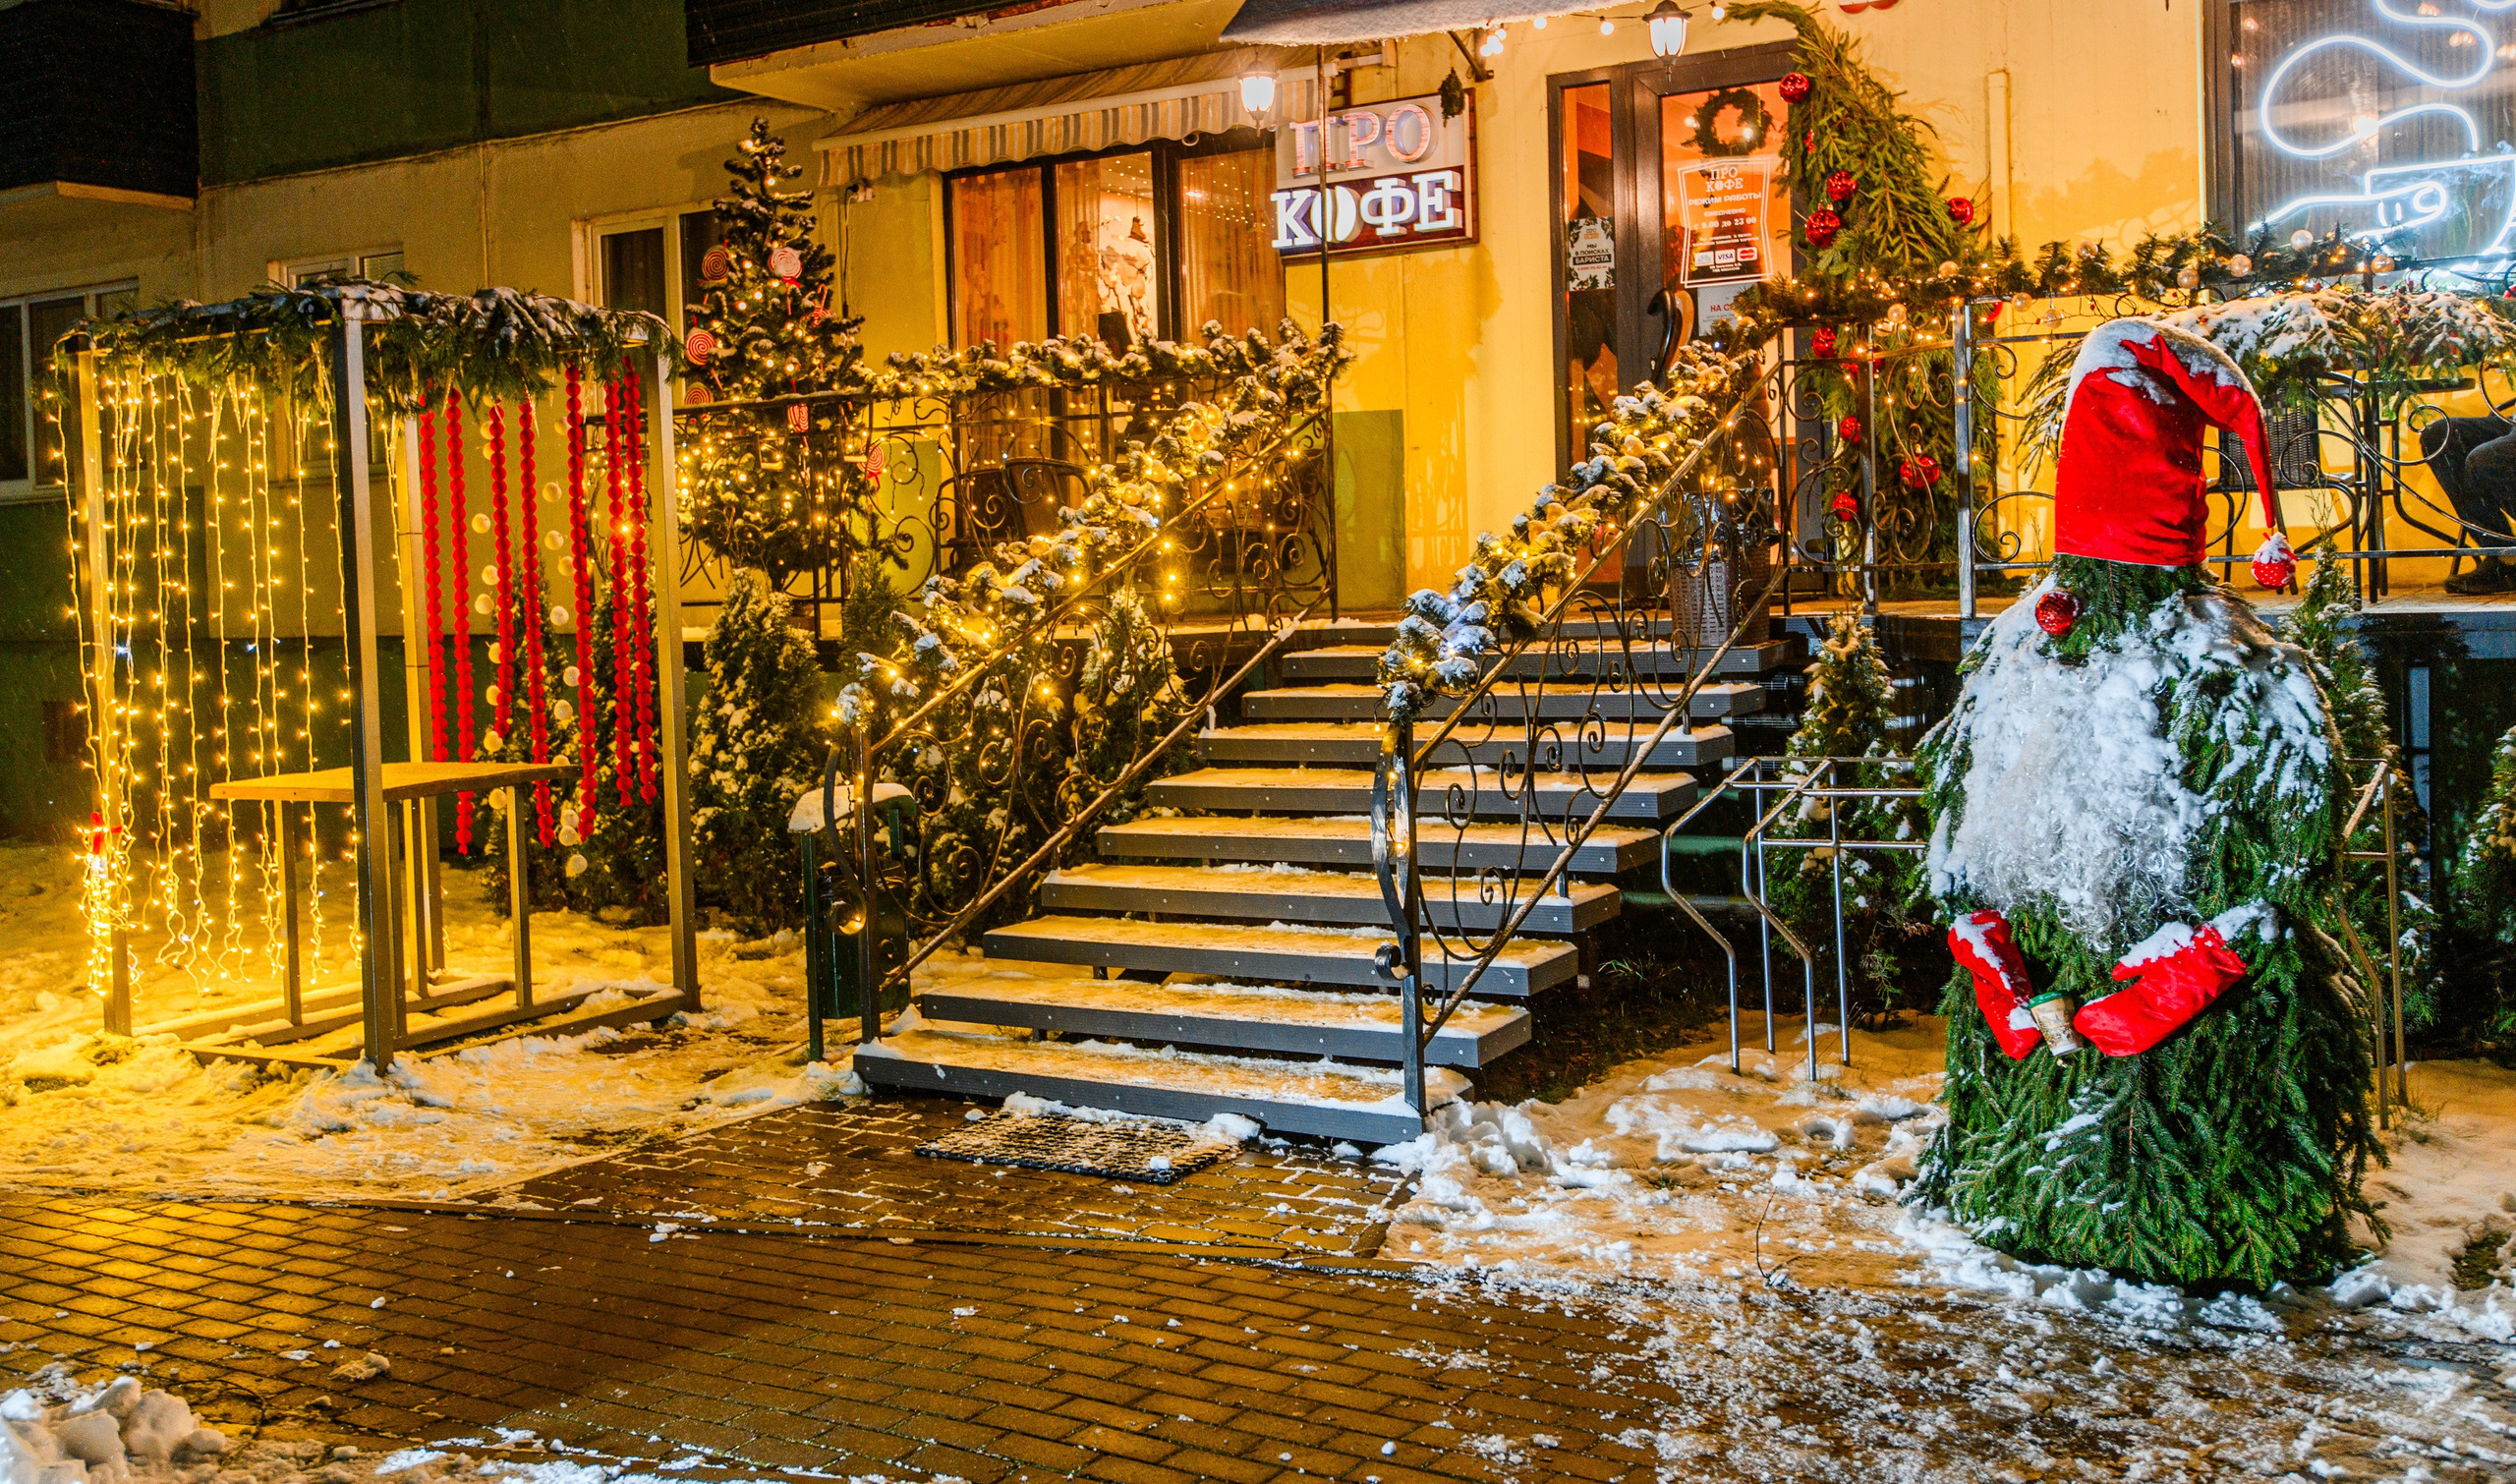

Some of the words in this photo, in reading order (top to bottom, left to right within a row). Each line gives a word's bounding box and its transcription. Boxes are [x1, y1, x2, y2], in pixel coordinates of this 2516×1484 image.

[1289, 103, 1436, 178] ПРО
[1710, 166, 1738, 180] ПРО
[1706, 178, 1744, 192] КОФЕ
[1688, 197, 1722, 206] РЕЖИМ
[1724, 192, 1761, 202] РАБОТЫ
[1271, 170, 1462, 249] КОФЕ
[1575, 256, 1609, 264] БАРИСТА
[1717, 252, 1734, 260] VISA
